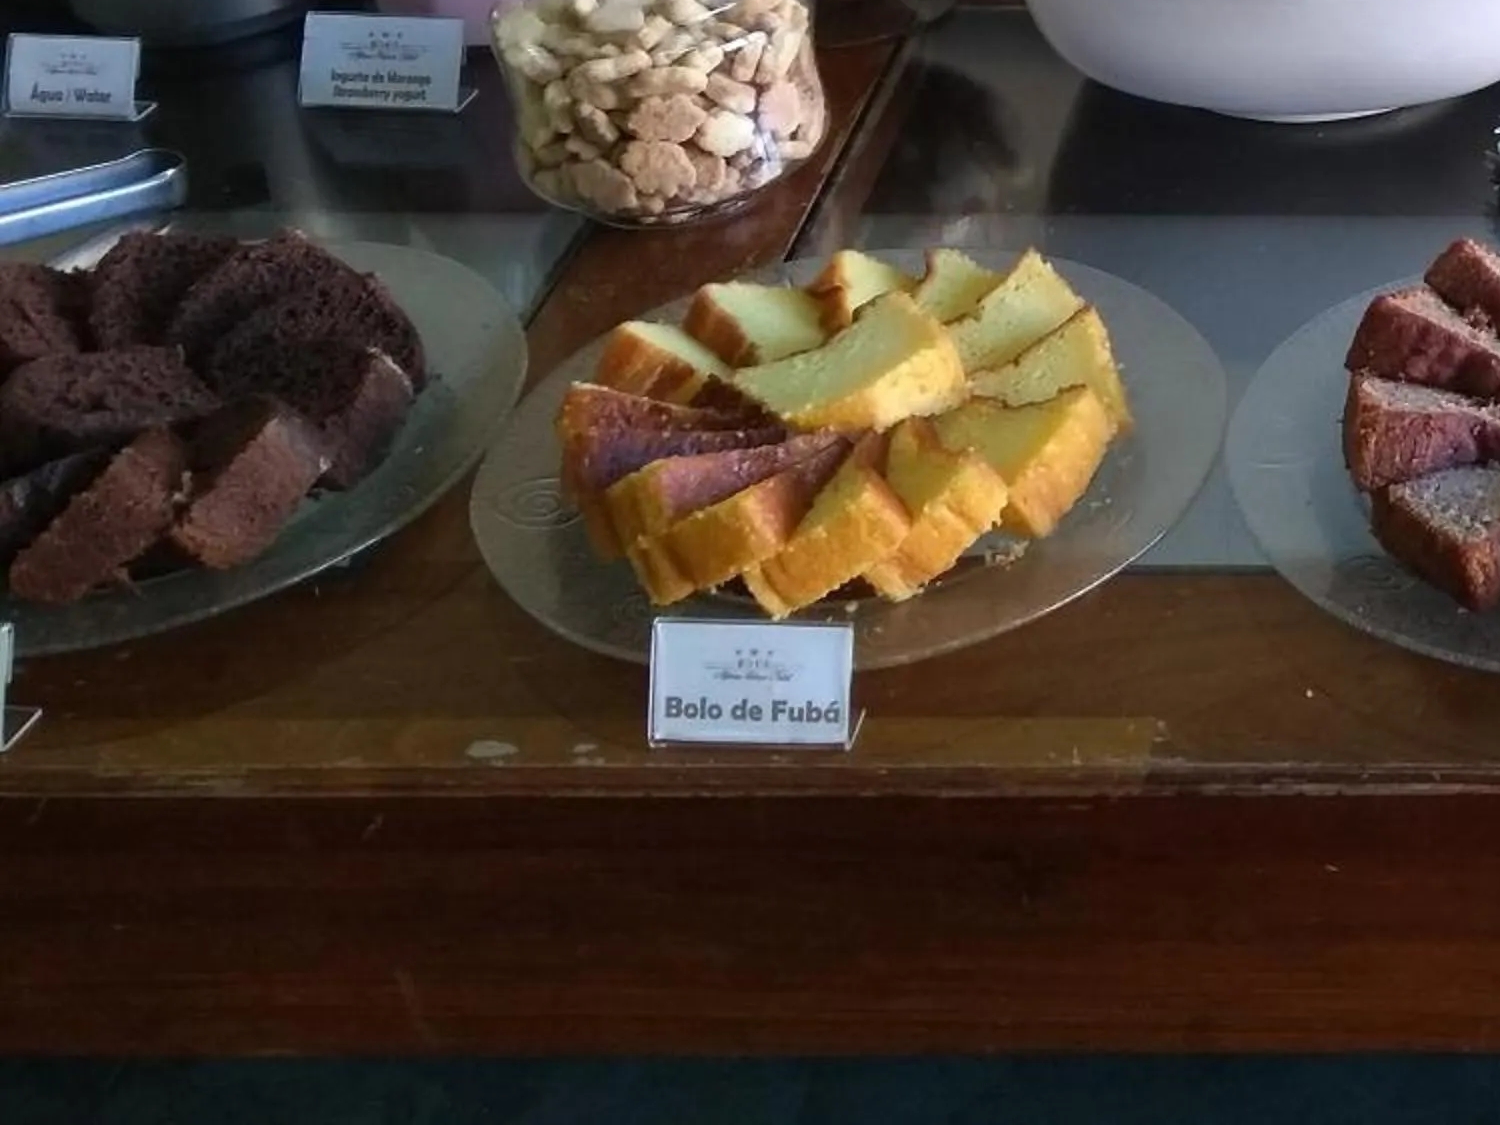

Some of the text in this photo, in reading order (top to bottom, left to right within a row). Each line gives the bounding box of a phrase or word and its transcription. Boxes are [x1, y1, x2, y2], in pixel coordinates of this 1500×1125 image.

[372, 69, 385, 84] de
[387, 70, 432, 87] Morango
[73, 88, 111, 104] Water
[392, 89, 427, 102] yogurt
[664, 696, 840, 724] Bolo de Fubá
